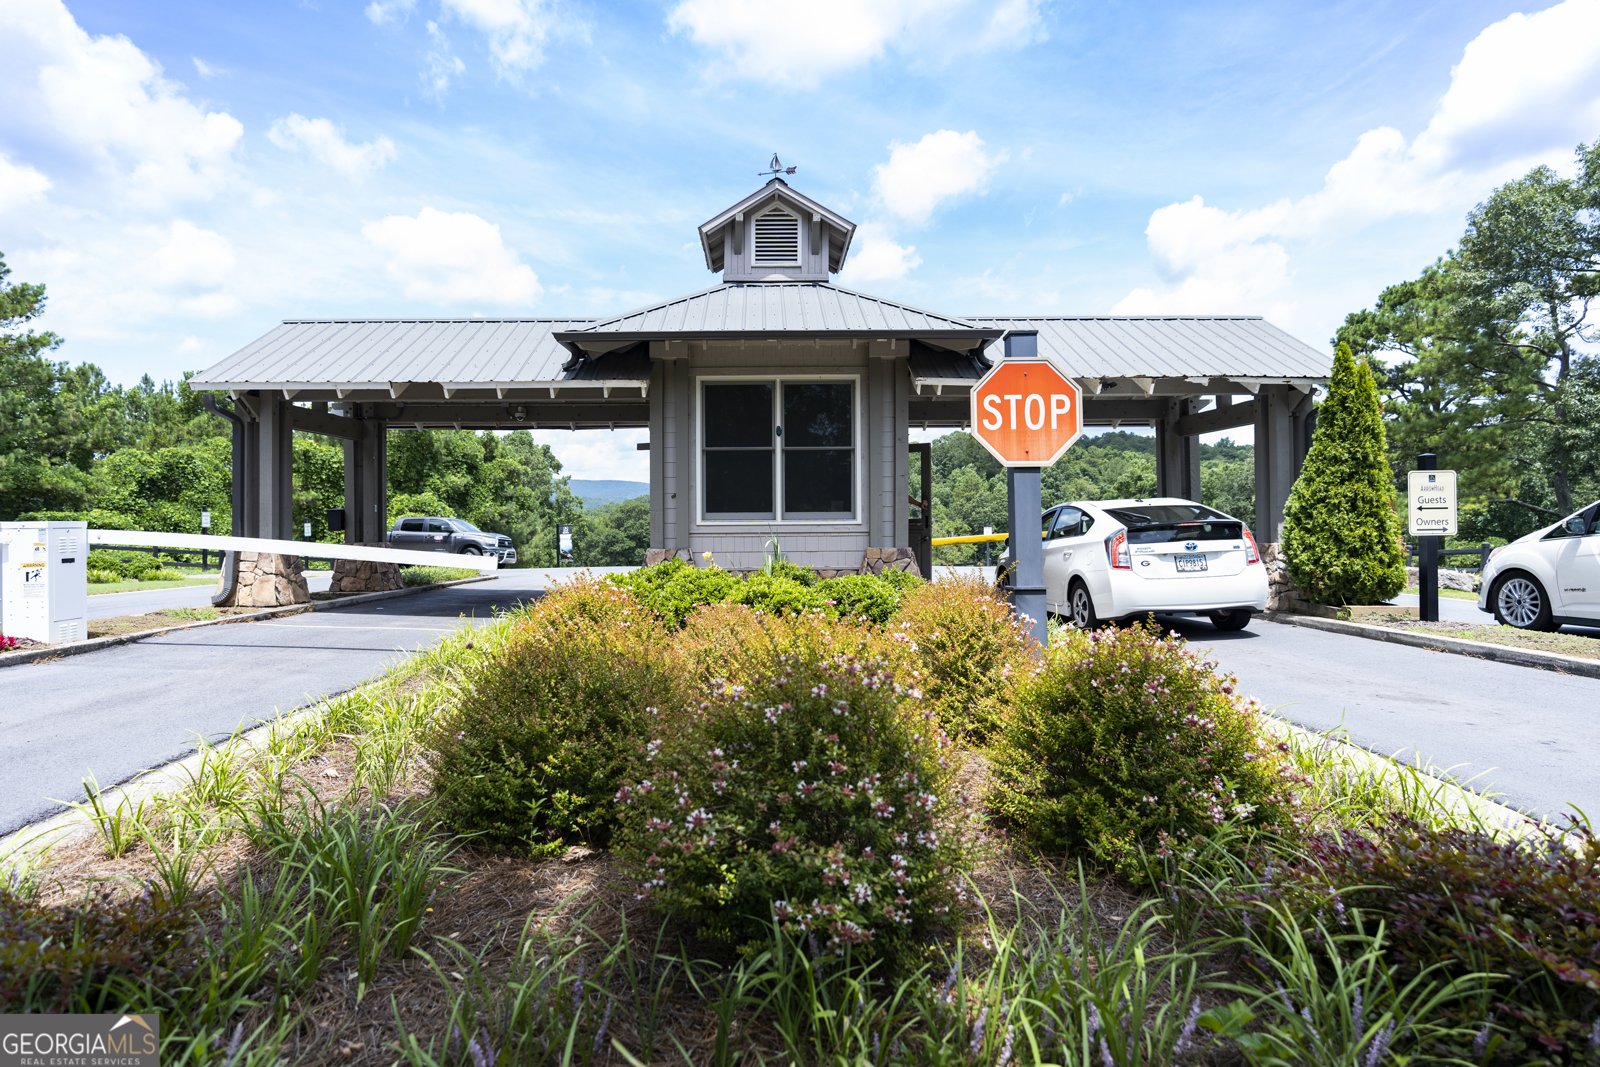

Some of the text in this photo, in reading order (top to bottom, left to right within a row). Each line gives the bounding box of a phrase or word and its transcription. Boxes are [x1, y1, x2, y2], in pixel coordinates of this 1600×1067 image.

[982, 393, 1071, 431] STOP
[1417, 495, 1447, 504] Guests
[1416, 517, 1449, 526] Owners
